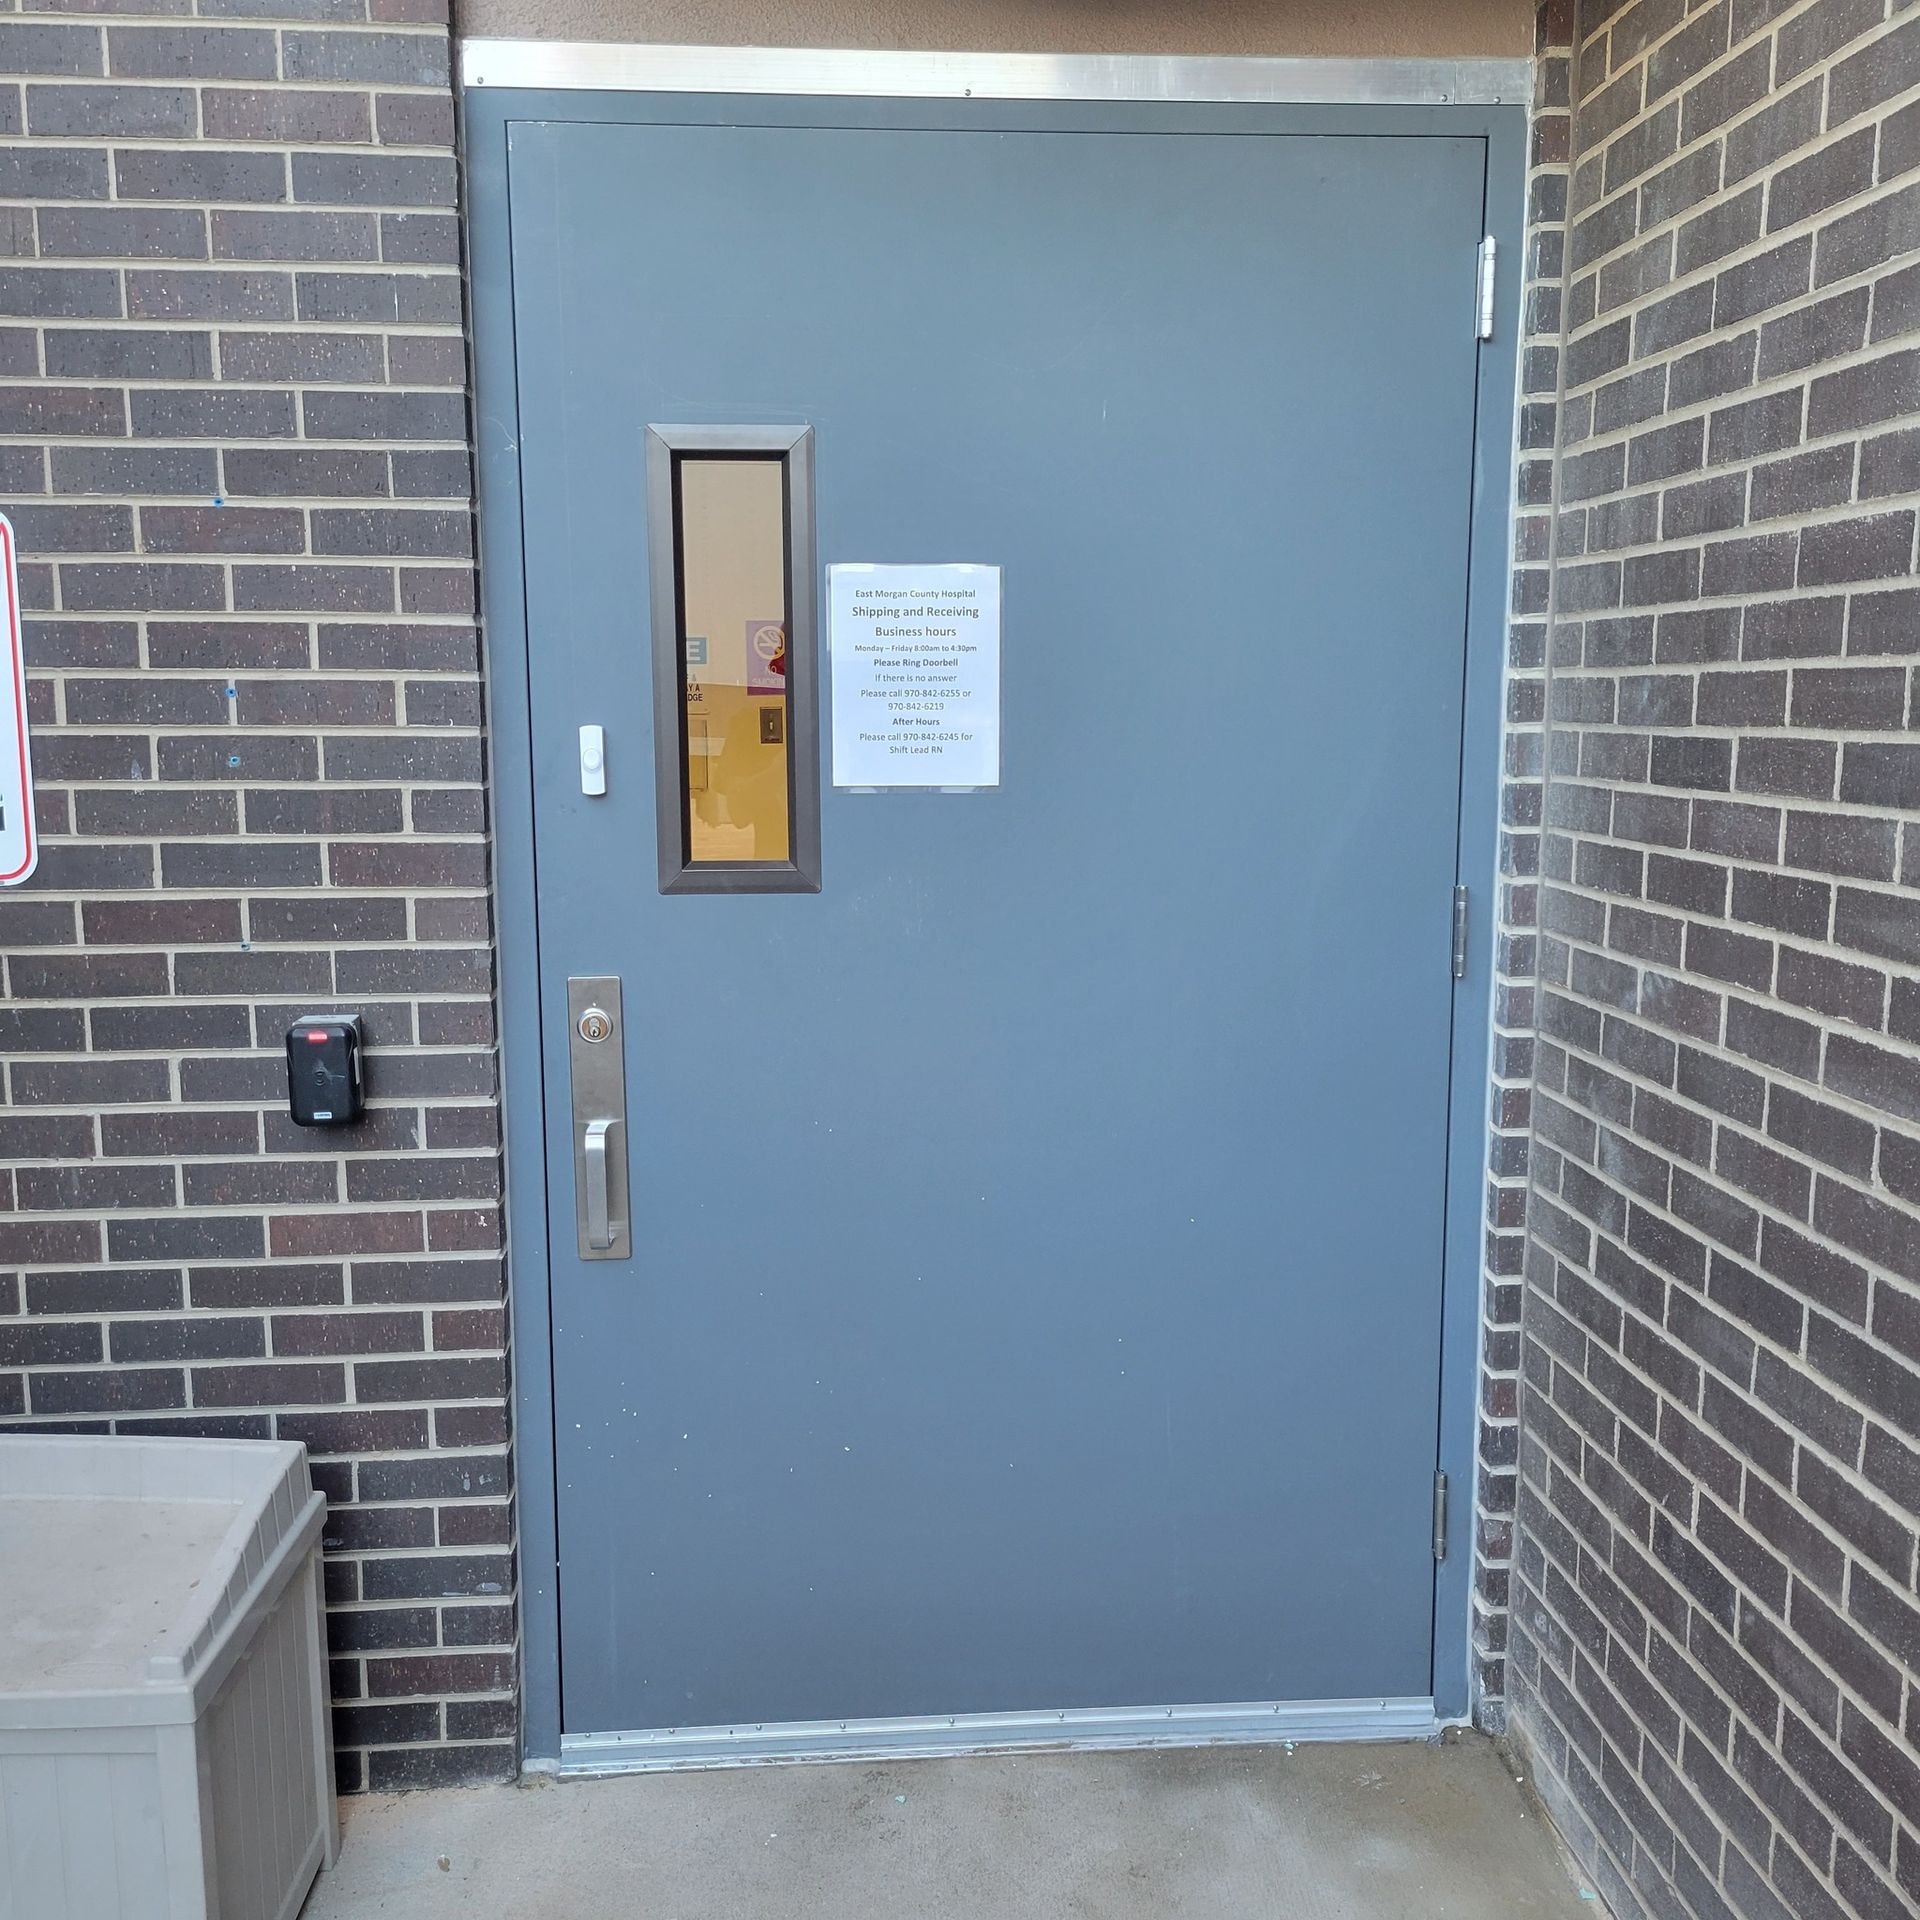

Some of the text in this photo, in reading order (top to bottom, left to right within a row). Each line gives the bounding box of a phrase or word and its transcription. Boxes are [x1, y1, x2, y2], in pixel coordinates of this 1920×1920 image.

[855, 589, 976, 599] East Morgan County Hospital
[852, 606, 979, 618] Shipping and Receiving
[875, 626, 957, 636] Business hours
[903, 659, 920, 668] Ring
[923, 658, 958, 666] Doorbell
[875, 674, 881, 682] If
[883, 674, 905, 682] there
[907, 674, 913, 682] is
[861, 689, 887, 697] Please
[889, 689, 903, 697] call
[904, 689, 960, 697] 970-842-6255
[860, 733, 973, 741] Please call 970-842-6245 for
[889, 746, 943, 754] Shift Lead RN
